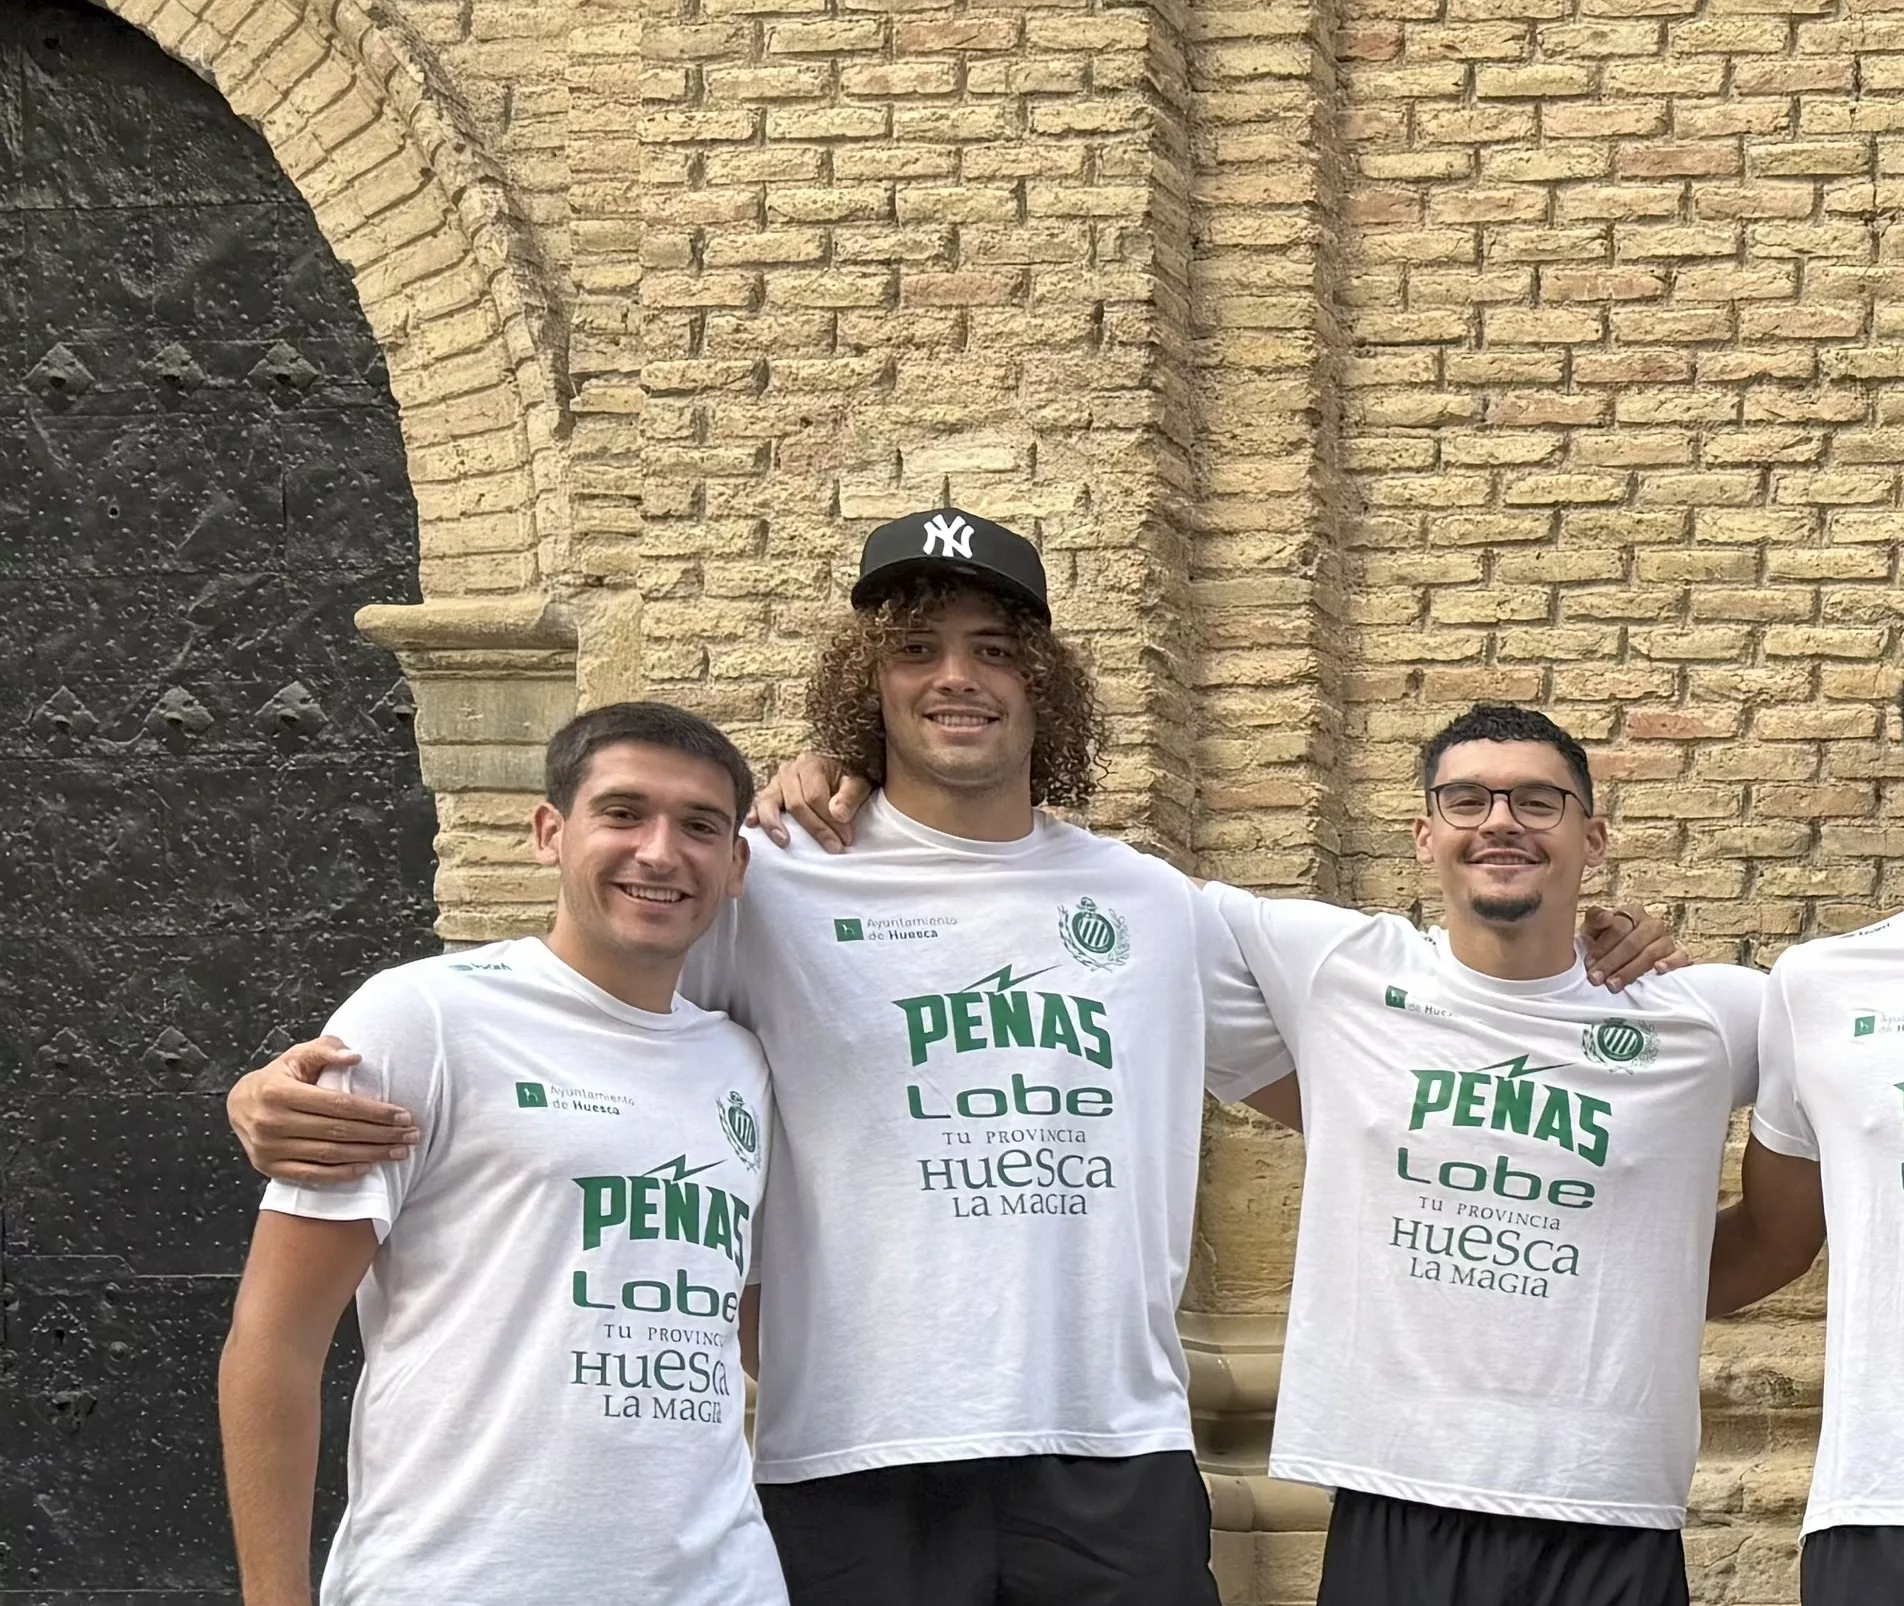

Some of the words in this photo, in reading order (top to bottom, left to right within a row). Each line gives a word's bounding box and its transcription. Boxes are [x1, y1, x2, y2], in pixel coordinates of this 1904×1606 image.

[923, 514, 975, 559] NY
[891, 964, 1113, 1069] PEÑAS
[907, 1073, 1113, 1120] Lobe
[1408, 1054, 1612, 1167] PEÑAS
[1397, 1147, 1595, 1209] Lobe
[571, 1154, 750, 1277] PEÑAS
[573, 1269, 738, 1323] Lobe
